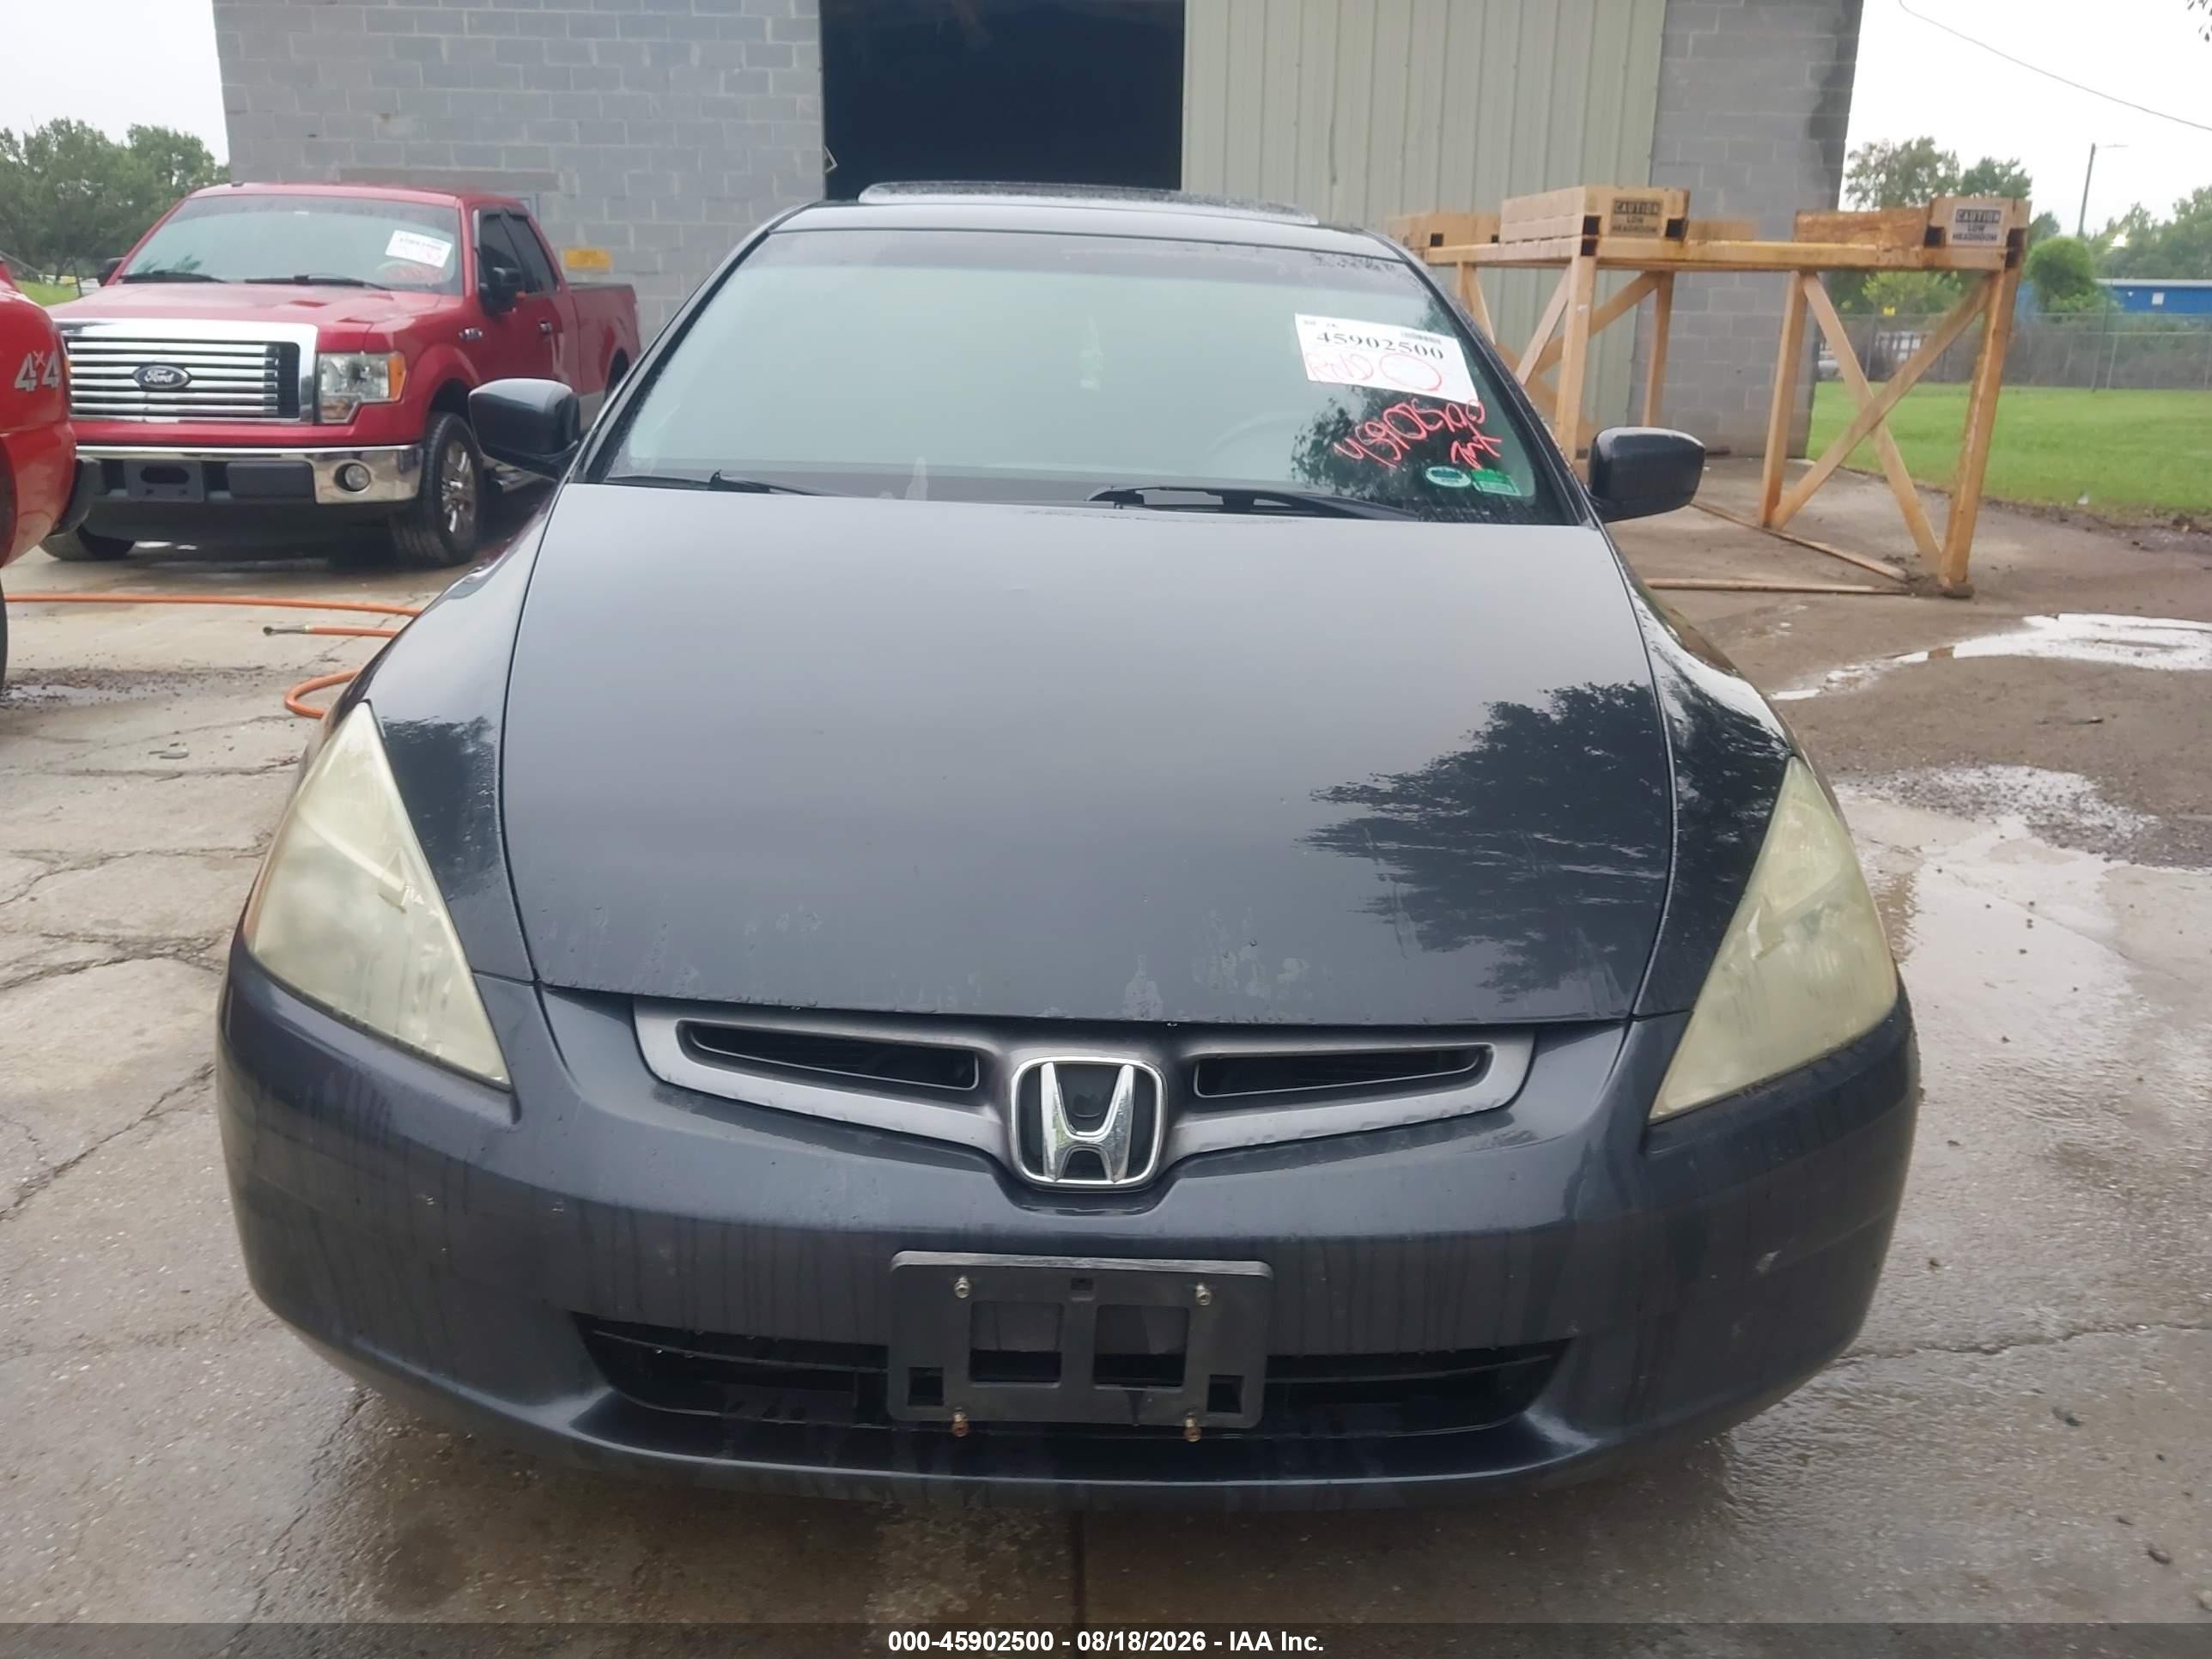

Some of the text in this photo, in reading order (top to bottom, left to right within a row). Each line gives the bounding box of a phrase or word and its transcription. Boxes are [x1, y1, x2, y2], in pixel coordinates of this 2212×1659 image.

[1614, 199, 1662, 215] CAUTION
[1956, 210, 2000, 223] CAUTION
[1316, 331, 1443, 360] 45902500
[143, 368, 175, 384] Ford
